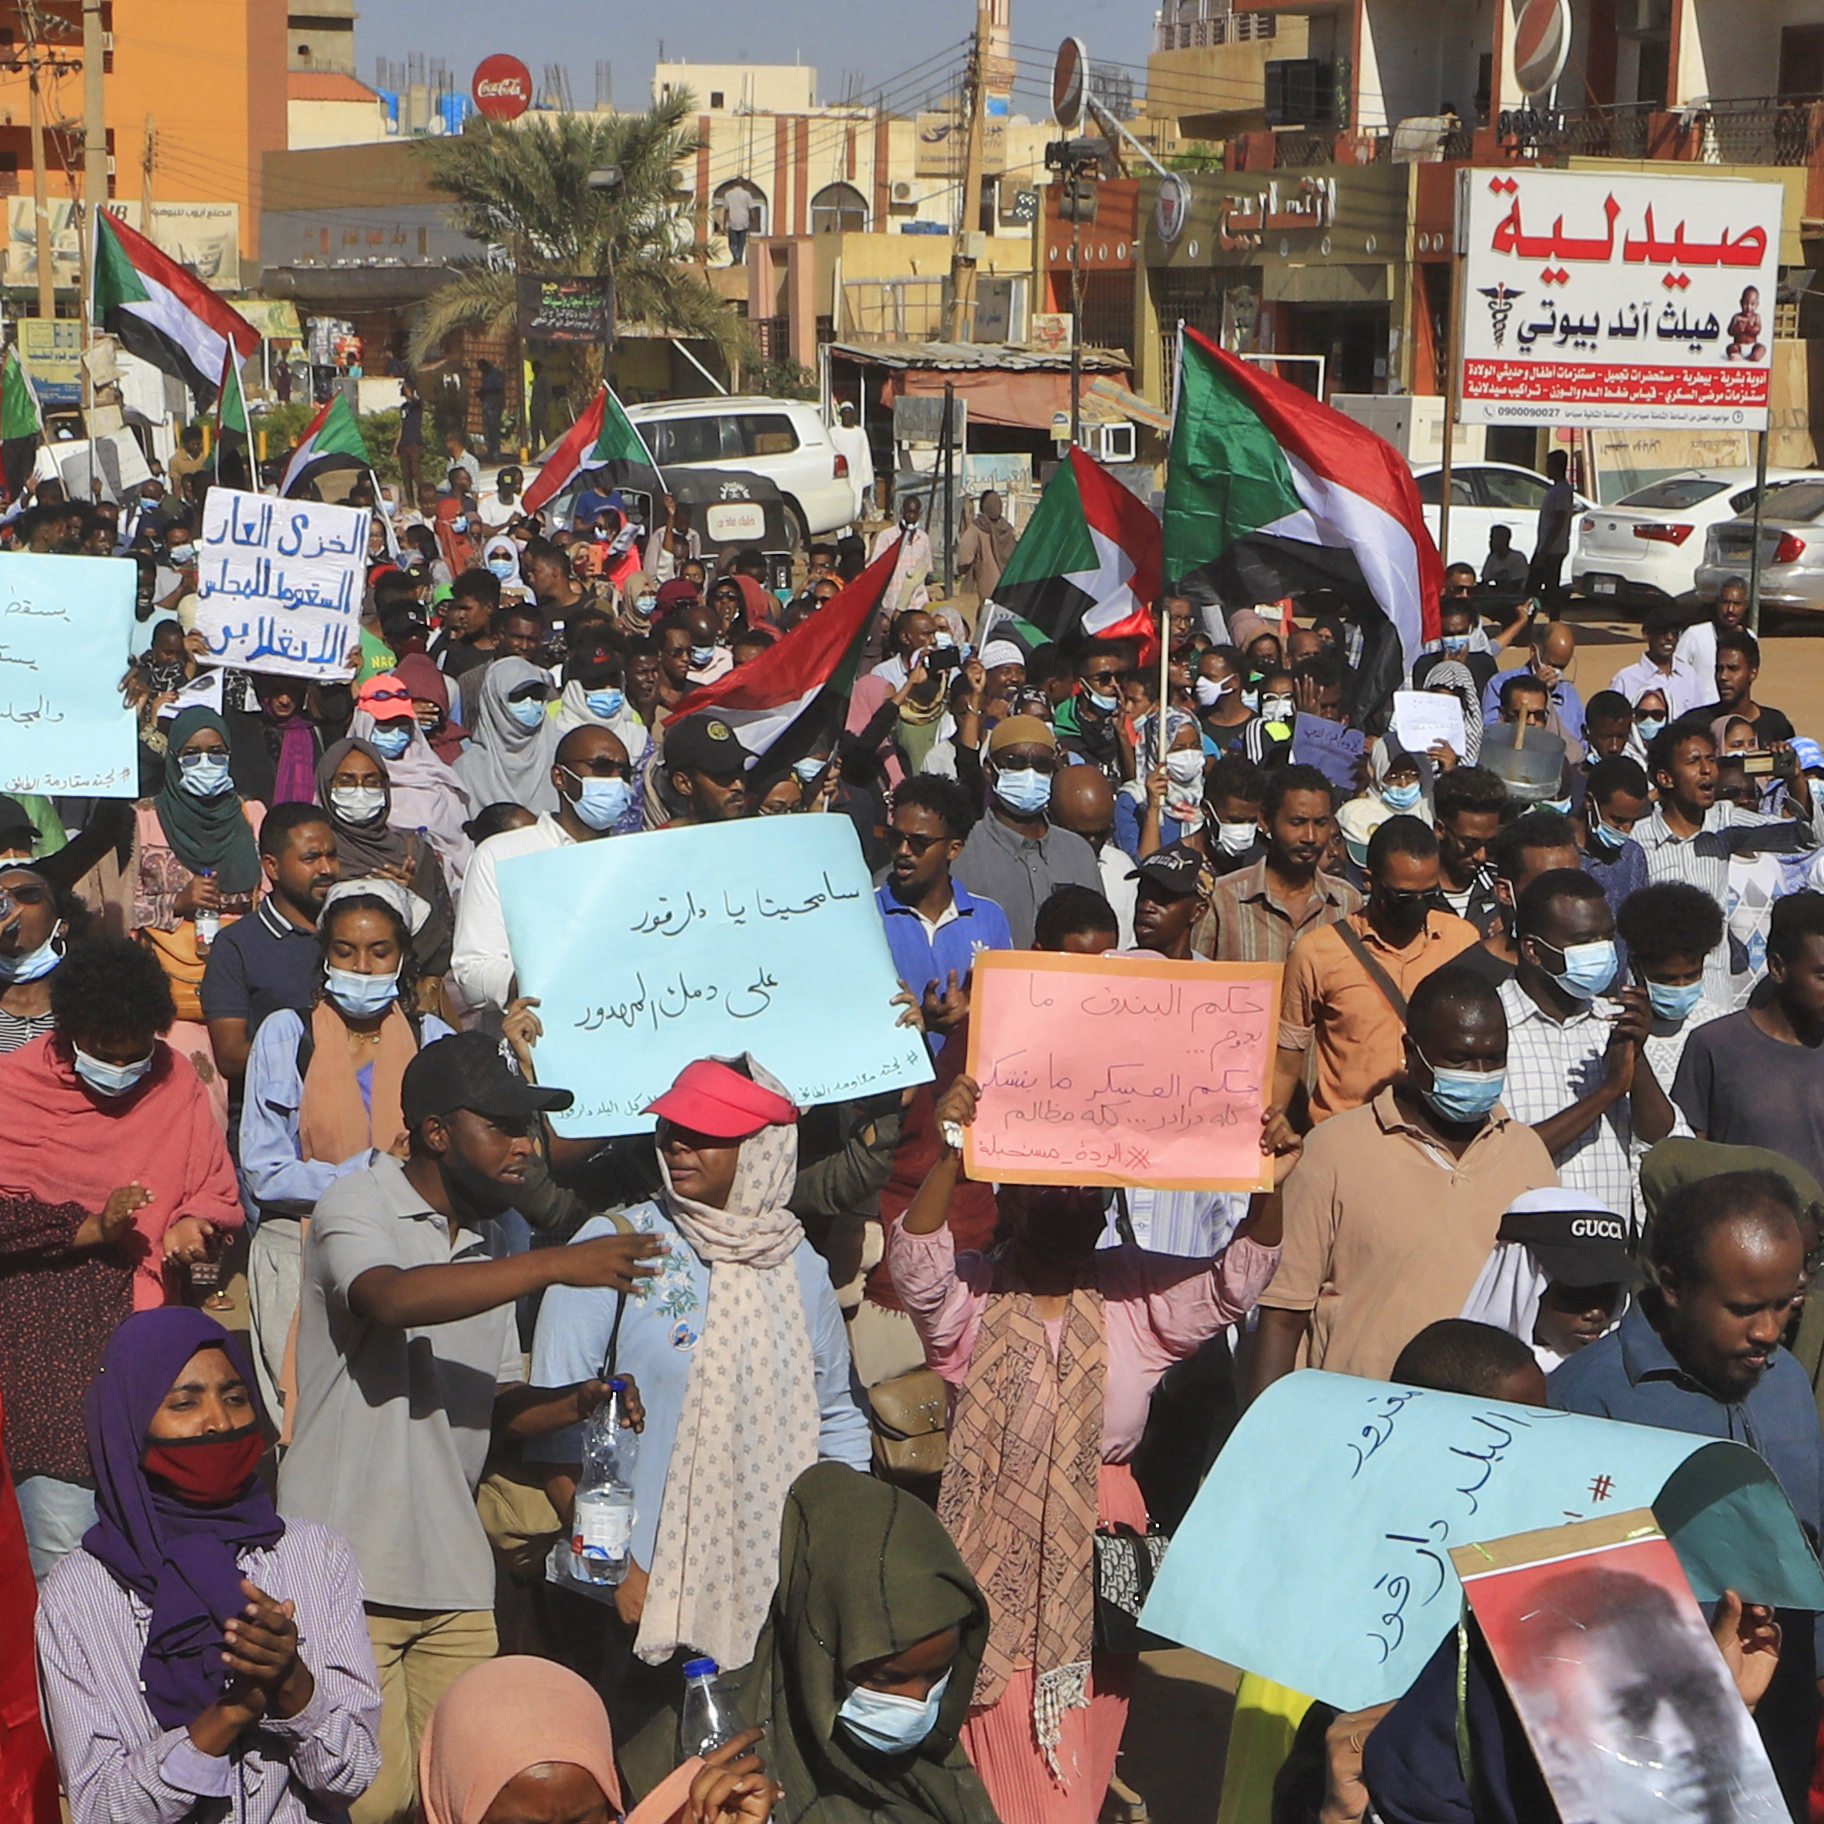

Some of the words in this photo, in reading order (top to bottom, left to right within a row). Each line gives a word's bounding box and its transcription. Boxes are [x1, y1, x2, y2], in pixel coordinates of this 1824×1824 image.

[1488, 176, 1768, 290] صيدلية
[1517, 298, 1602, 355] بيوتي
[1608, 300, 1653, 339] آند
[1656, 301, 1721, 352] هيلث
[1468, 363, 1496, 377] الولادة
[1530, 365, 1556, 380] أطفال
[1557, 366, 1596, 381] مستلزمات
[1603, 367, 1629, 383] تجميل
[1631, 369, 1675, 383] مستحضرات
[1629, 386, 1657, 401] قياس
[1665, 385, 1698, 404] السكري
[1498, 407, 1561, 418] 0900090027
[206, 495, 273, 548] العار
[198, 557, 271, 601] للمجلس
[269, 570, 354, 615] السقوط
[723, 890, 747, 924] يا
[1028, 972, 1054, 1007] ما
[1191, 985, 1264, 1032] حكم
[1048, 1052, 1072, 1090] ما
[1085, 1063, 1180, 1103] العسكر
[1188, 1069, 1259, 1107] حكم
[1587, 1473, 1617, 1504] #
